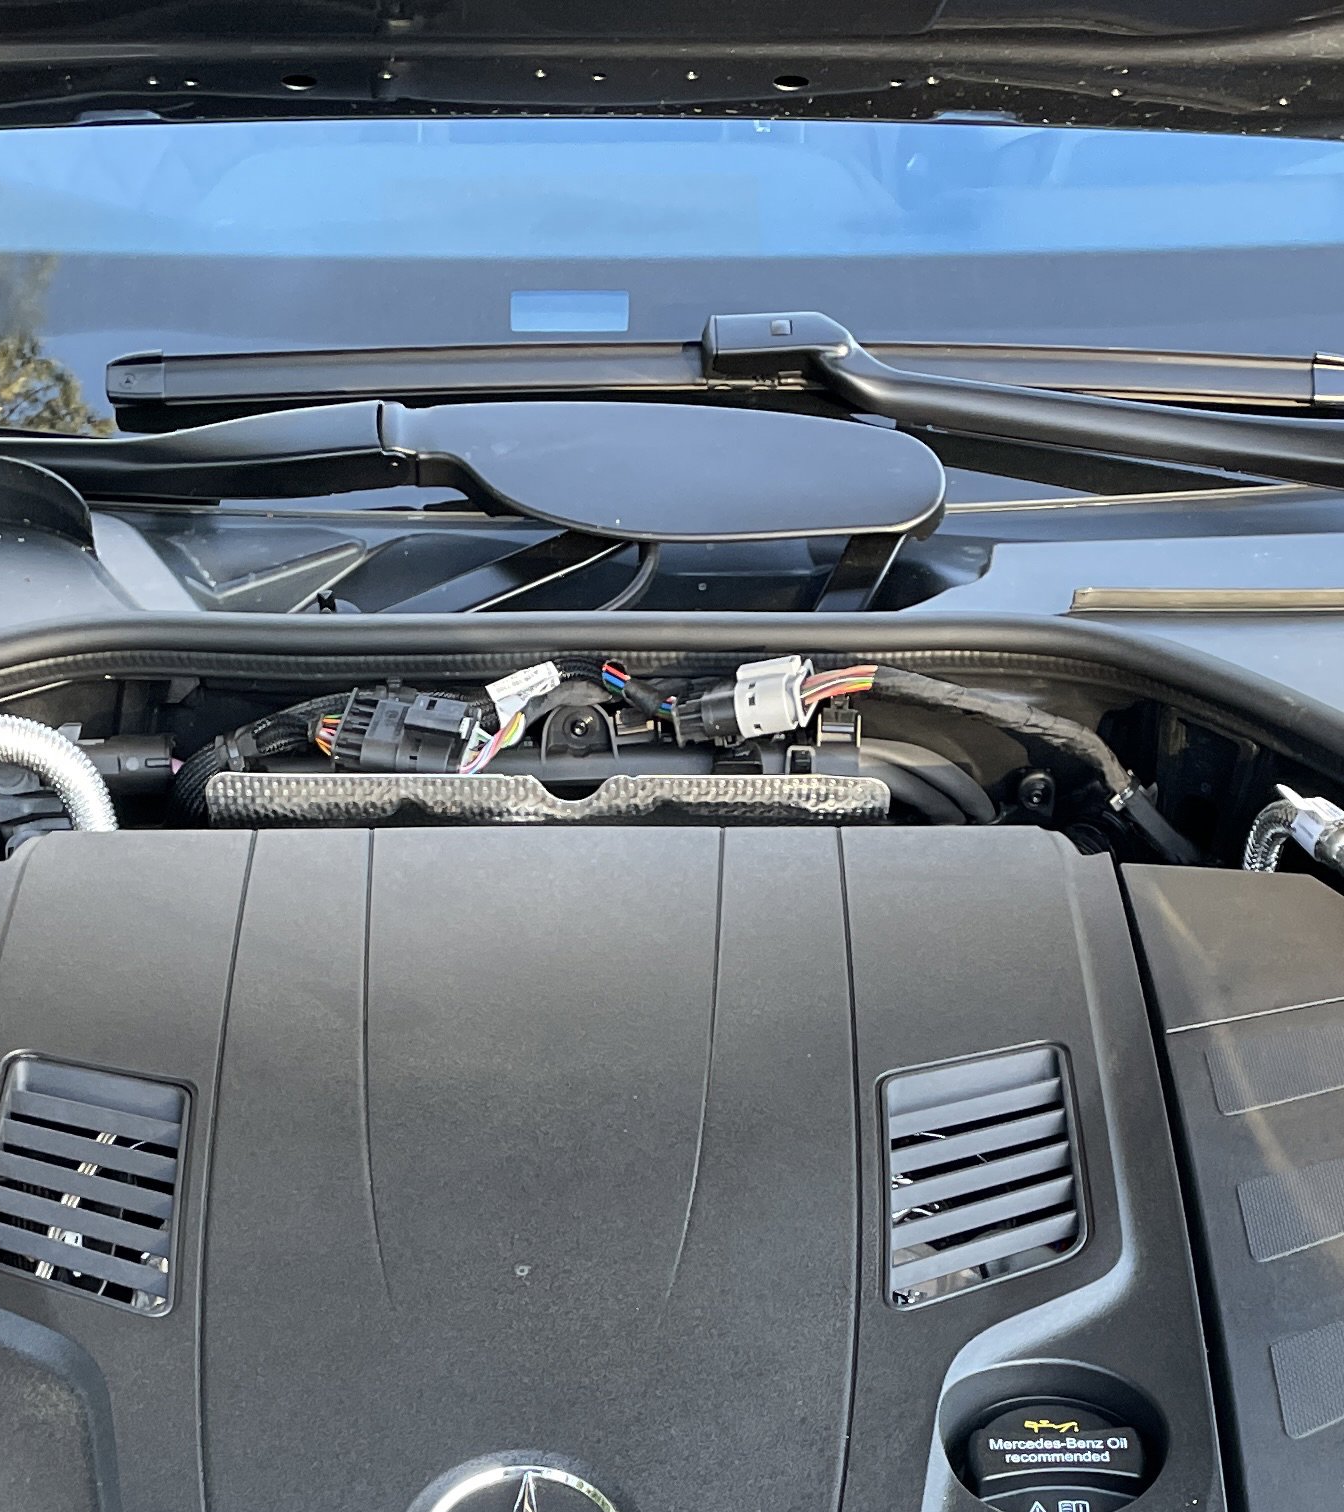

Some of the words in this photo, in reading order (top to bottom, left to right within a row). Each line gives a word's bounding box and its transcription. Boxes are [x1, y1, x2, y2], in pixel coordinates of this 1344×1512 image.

[988, 1437, 1104, 1450] Mercedes-Benz
[1107, 1437, 1128, 1449] Oil
[1004, 1451, 1110, 1463] recommended
